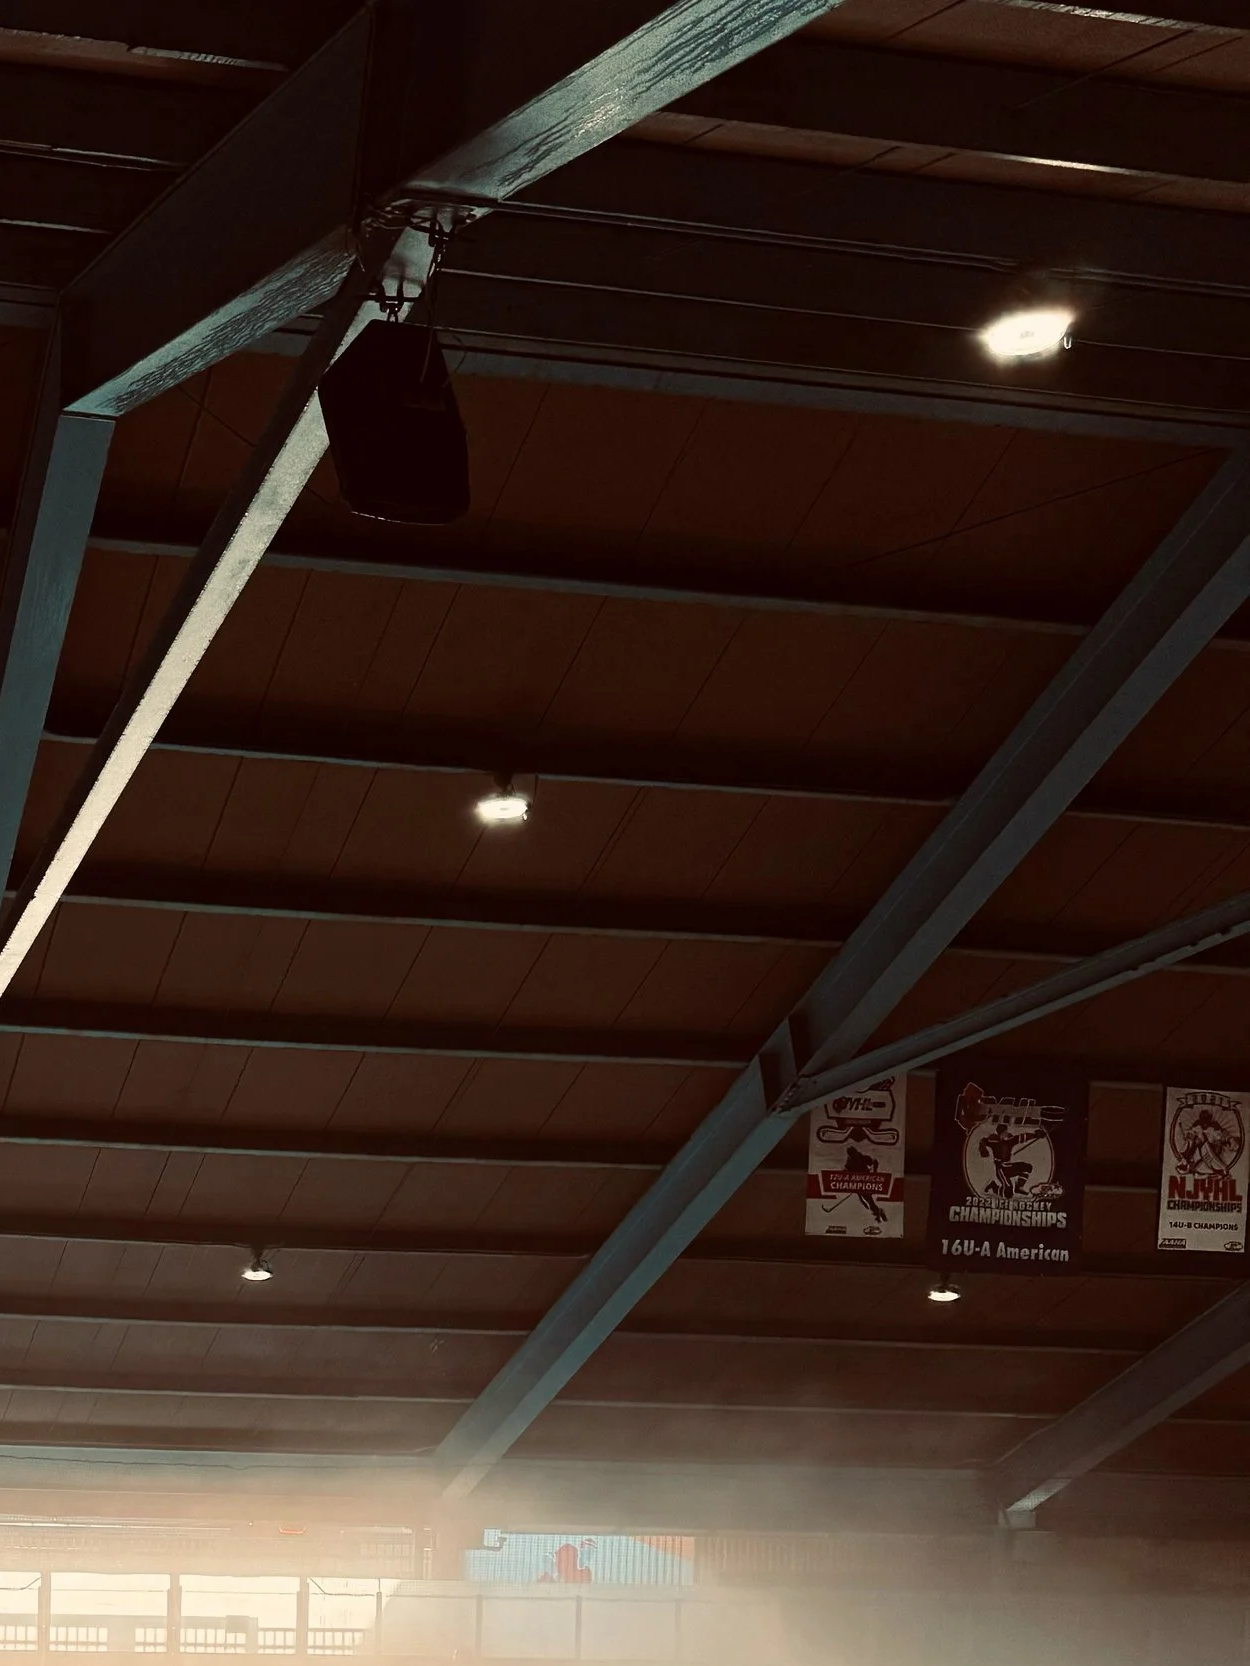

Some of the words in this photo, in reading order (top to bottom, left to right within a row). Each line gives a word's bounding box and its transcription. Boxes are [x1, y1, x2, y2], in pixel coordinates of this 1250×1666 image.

[830, 1181, 883, 1191] CHAMPIONS
[851, 1175, 885, 1183] AMERICAN
[1168, 1176, 1243, 1201] NJYHL
[966, 1196, 990, 1206] 2022
[1010, 1200, 1052, 1211] HOCKEY
[1167, 1199, 1242, 1213] CHAMPIONSHIPS
[949, 1206, 1068, 1228] CHAMPIONSHIPS
[1193, 1222, 1239, 1231] CHAMPIONS
[941, 1239, 991, 1257] 16U-A
[996, 1242, 1070, 1262] American
